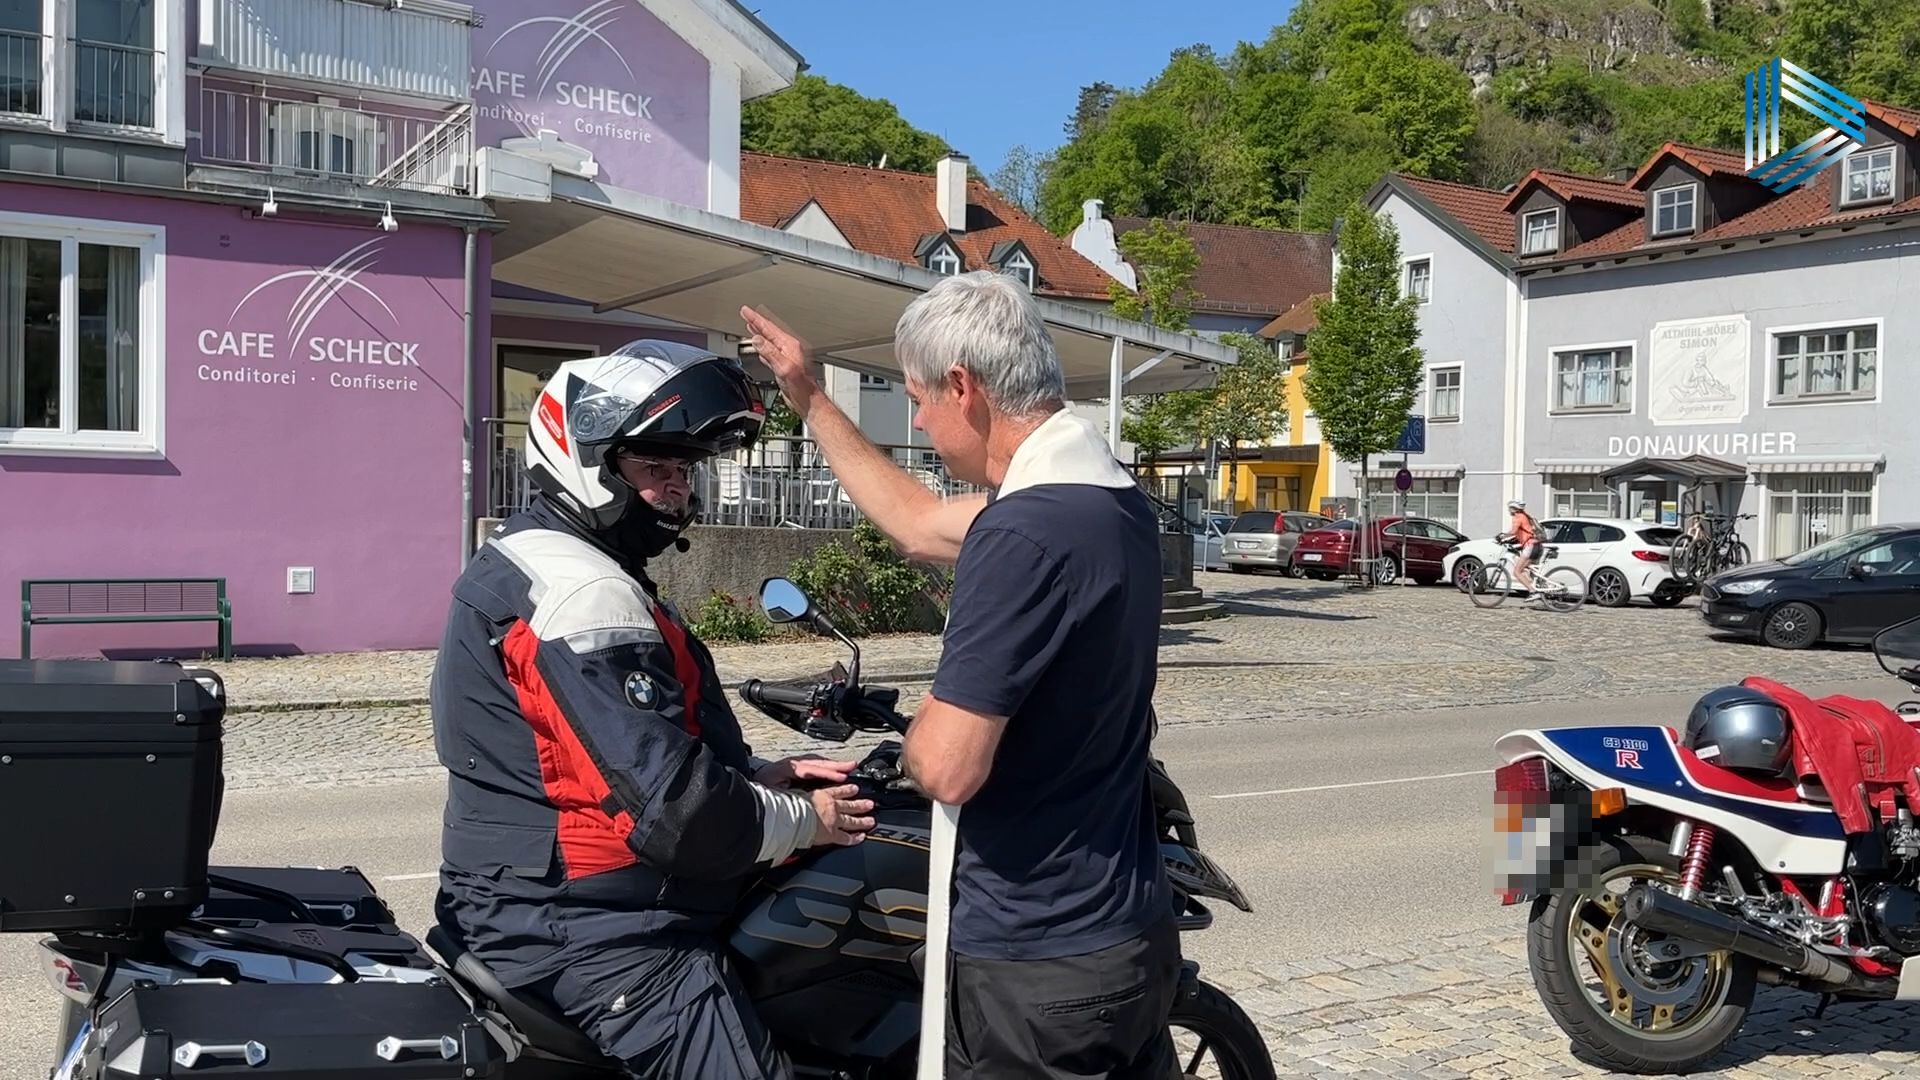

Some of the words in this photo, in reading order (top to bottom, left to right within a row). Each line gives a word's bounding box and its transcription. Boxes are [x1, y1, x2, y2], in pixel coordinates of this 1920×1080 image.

[471, 66, 526, 98] AFE
[556, 81, 652, 119] SCHECK
[575, 118, 652, 143] Confiserie
[198, 329, 274, 358] CAFE
[309, 336, 419, 366] SCHECK
[1680, 337, 1717, 349] SIMON
[198, 364, 296, 384] Conditorei
[330, 372, 418, 391] Confiserie
[1608, 431, 1797, 457] DONAUKURIER
[1603, 736, 1620, 748] CB
[1615, 749, 1644, 769] R
